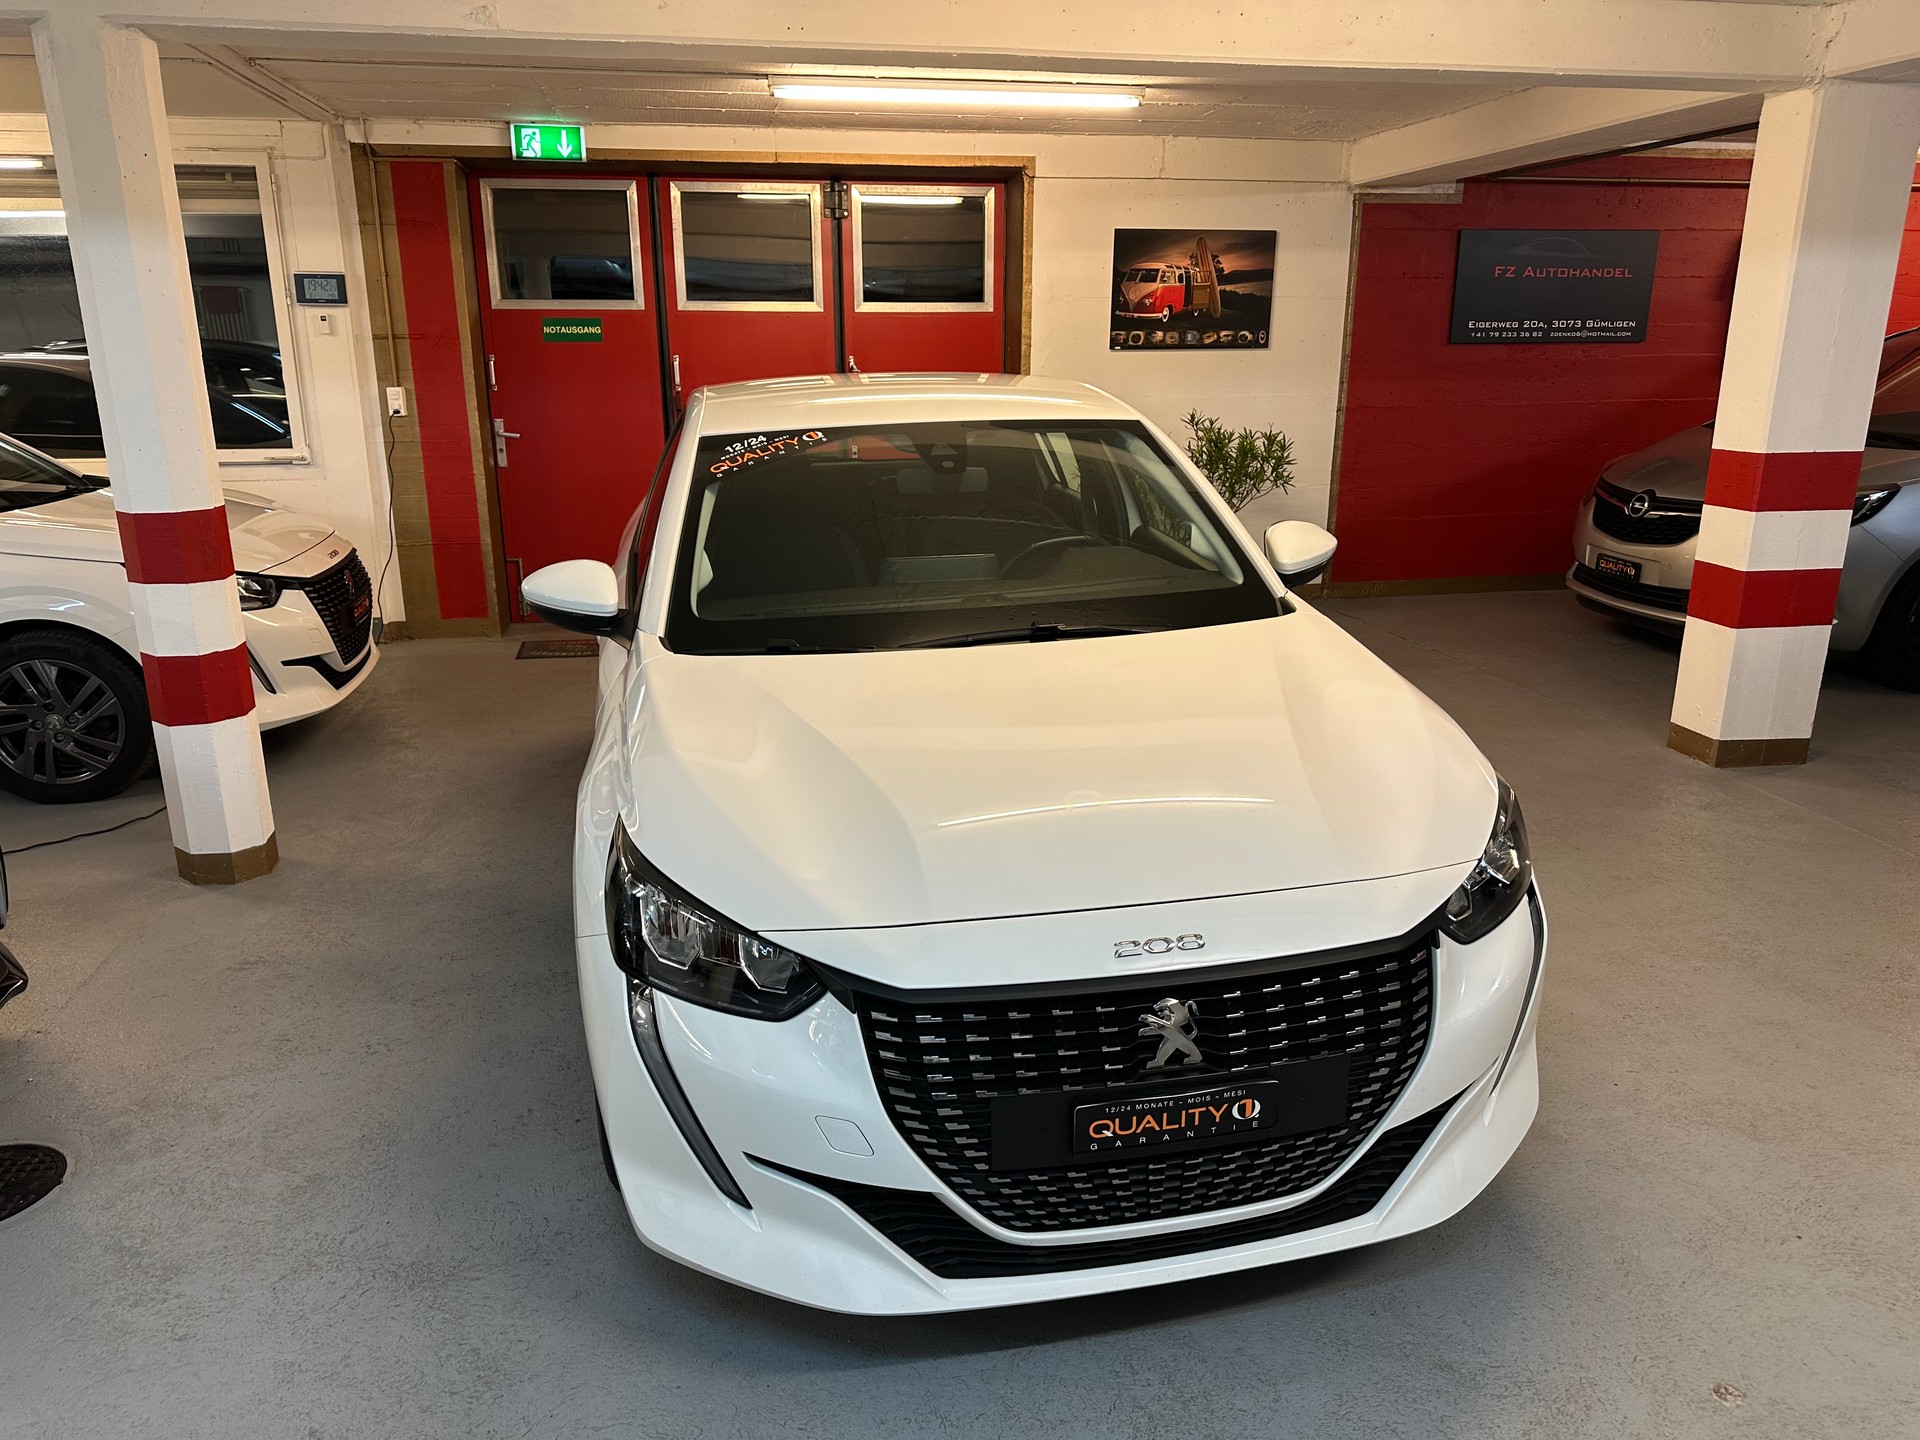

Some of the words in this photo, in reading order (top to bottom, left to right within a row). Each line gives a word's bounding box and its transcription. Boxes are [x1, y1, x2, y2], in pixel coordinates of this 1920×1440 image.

[1494, 266, 1516, 278] FZ
[1523, 266, 1633, 278] AUTOHANDEL
[543, 326, 601, 334] NOTAUSGANG
[1468, 320, 1519, 328] EIGERWEG
[1551, 320, 1582, 328] 3073
[1586, 319, 1636, 328] GÜMLIGEN
[724, 435, 767, 452] 12/24
[710, 436, 798, 472] QUALITY
[1599, 559, 1628, 573] QUALITY
[1113, 933, 1206, 958] 208
[1105, 1105, 1131, 1113] 12/24
[1135, 1101, 1175, 1110] MONATE
[1187, 1094, 1211, 1104] MOIS
[1223, 1089, 1246, 1098] MESI
[1088, 1103, 1229, 1139] QUALITY
[1090, 1120, 1259, 1151] GARANTIE
